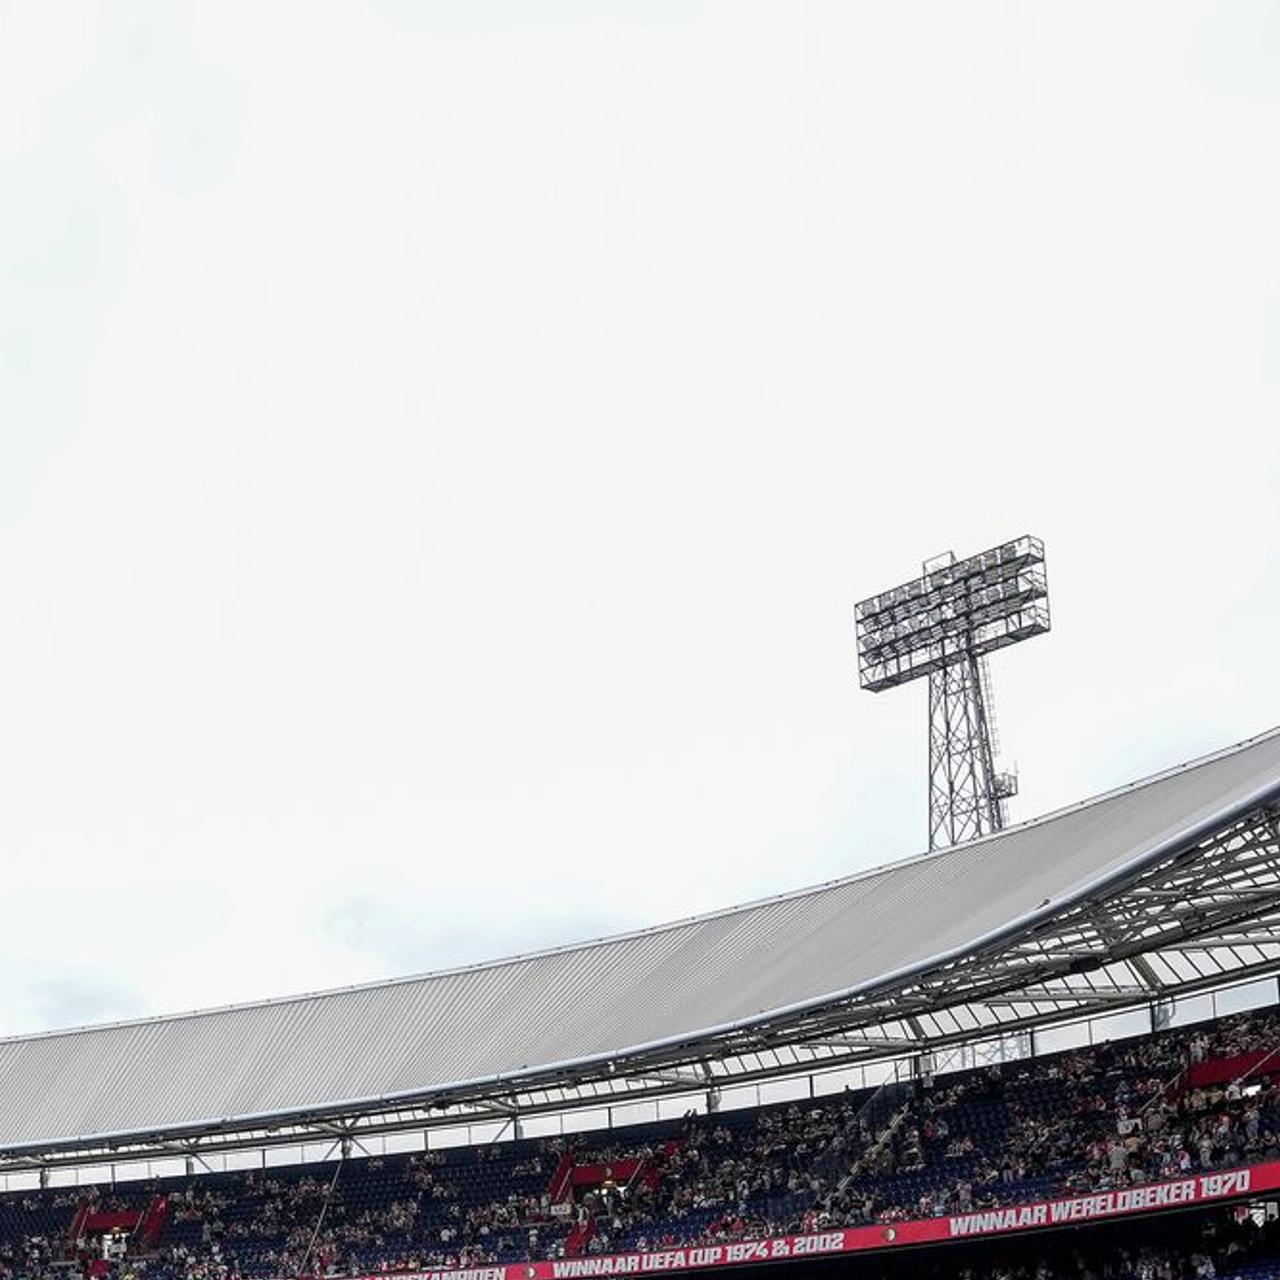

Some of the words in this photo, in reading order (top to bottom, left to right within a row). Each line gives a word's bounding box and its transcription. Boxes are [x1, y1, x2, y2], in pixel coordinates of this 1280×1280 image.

[949, 1205, 1045, 1236] WINNAAR
[1050, 1178, 1195, 1222] WERELDBEKER
[1198, 1169, 1250, 1198] 1970
[553, 1253, 641, 1278] WINNAAR
[642, 1248, 687, 1270] UEFA
[689, 1245, 723, 1267] CUP
[725, 1241, 770, 1262] 1974
[792, 1232, 844, 1254] 2002
